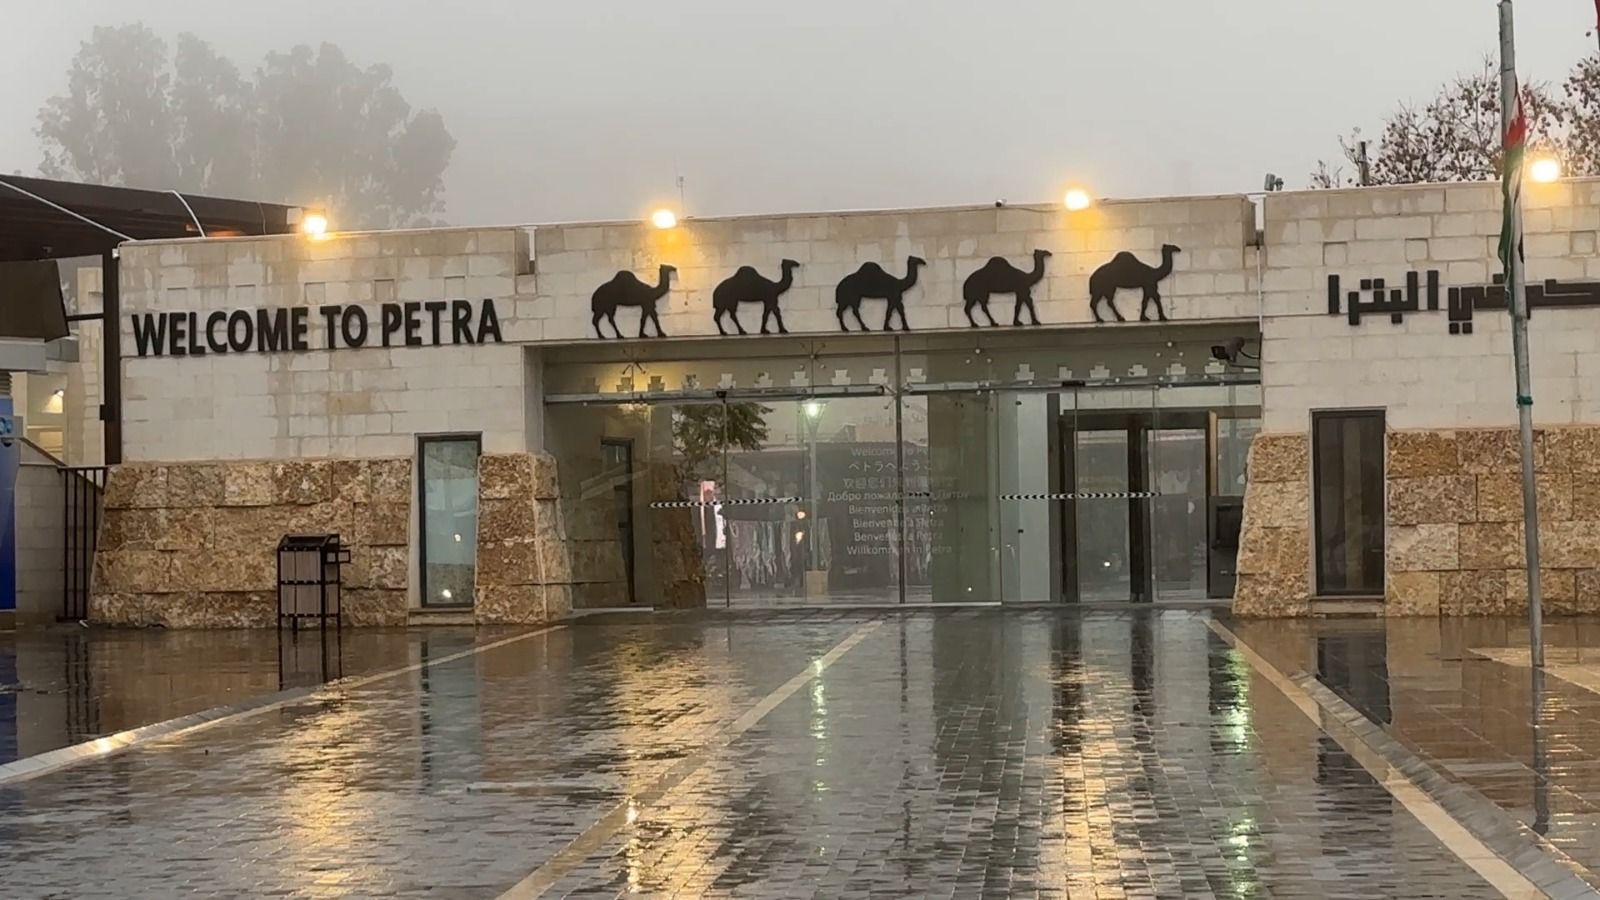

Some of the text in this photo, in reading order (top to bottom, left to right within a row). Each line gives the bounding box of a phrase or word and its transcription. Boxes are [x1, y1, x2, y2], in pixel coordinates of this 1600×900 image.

[1327, 269, 1439, 326] البترا
[131, 299, 503, 357] WELCOME TO PETRA
[827, 491, 862, 503] Добро
[848, 504, 909, 515] Bienvenid
[847, 545, 910, 556] Willkomn
